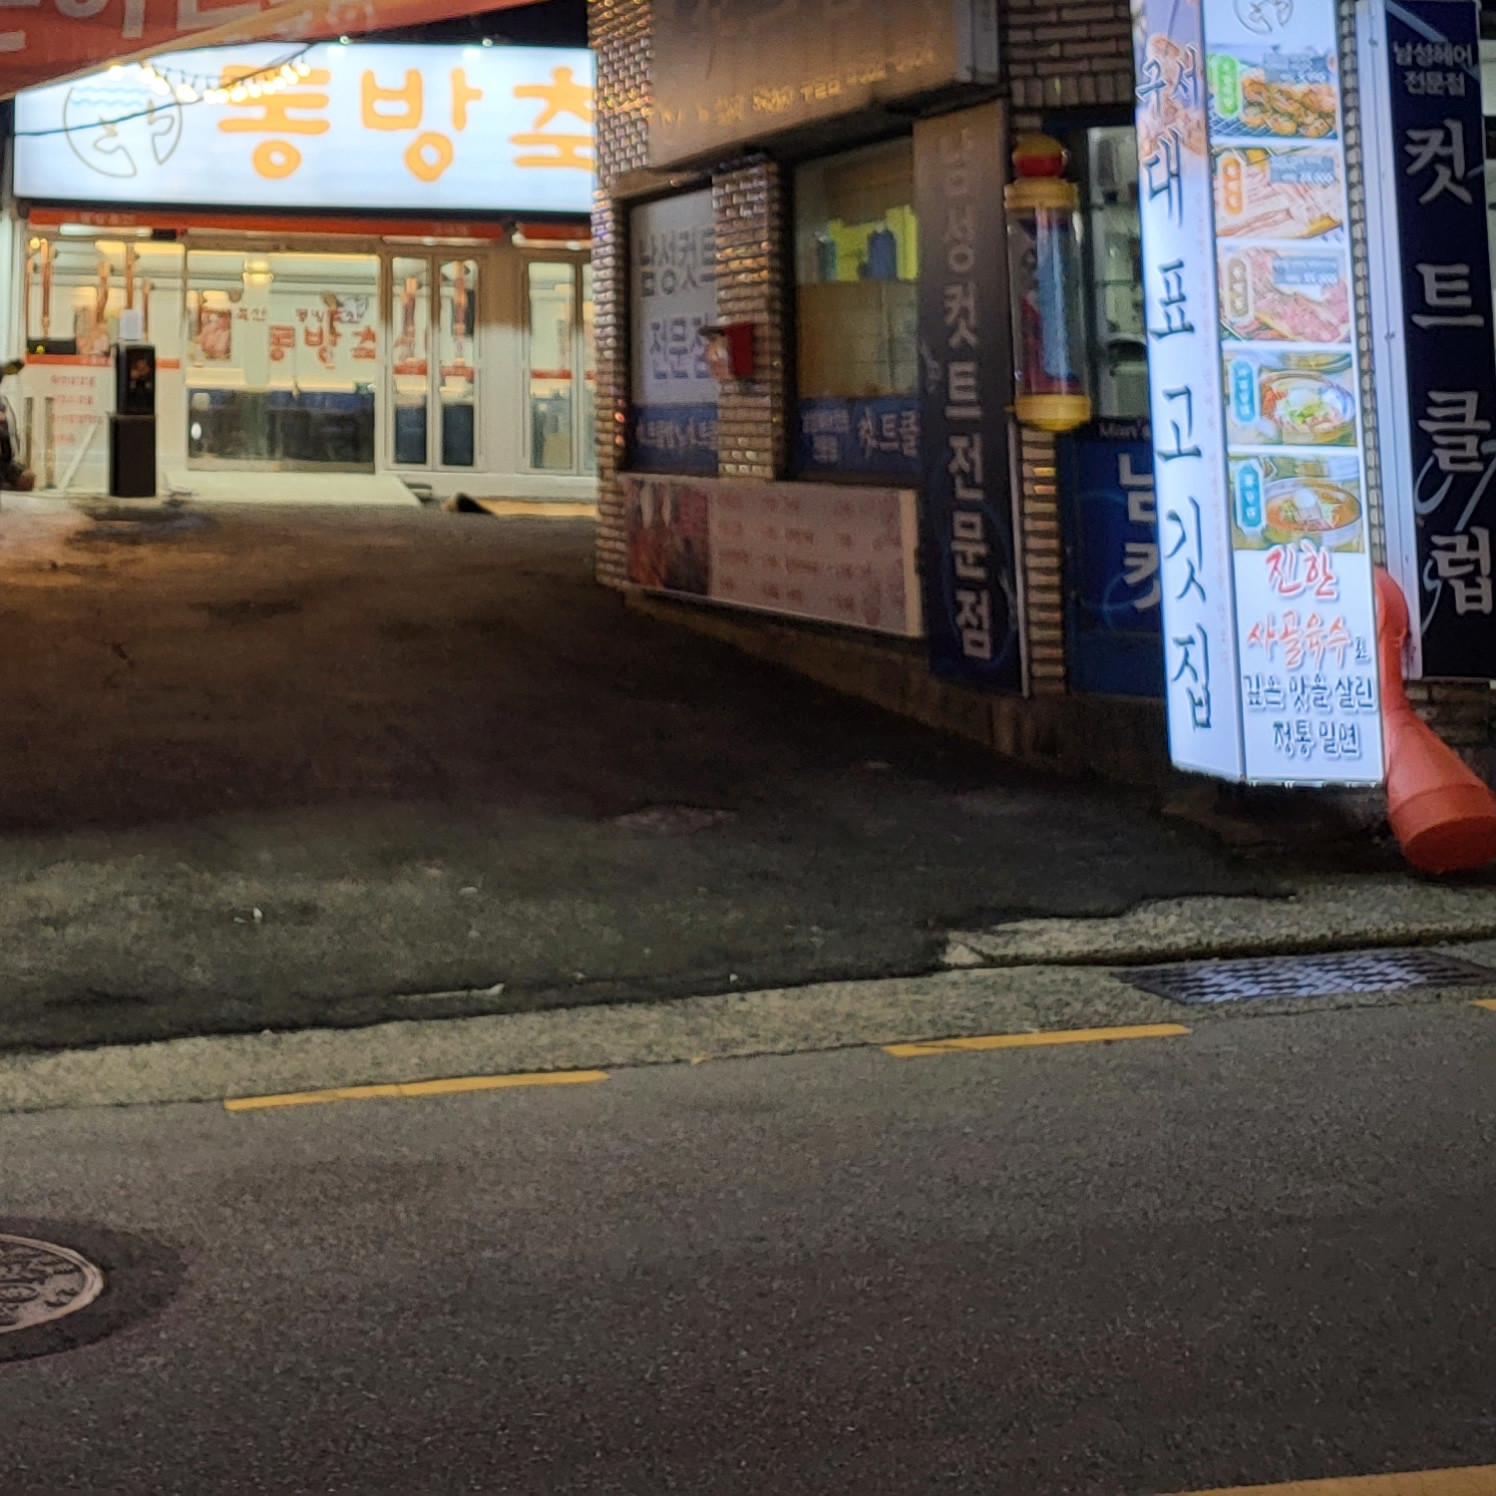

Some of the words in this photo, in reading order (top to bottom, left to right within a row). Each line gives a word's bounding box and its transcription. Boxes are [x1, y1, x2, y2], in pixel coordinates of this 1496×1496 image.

[1264, 541, 1338, 600] 진한
[1243, 675, 1285, 709] 깊은
[1288, 673, 1332, 711] 맛을
[1334, 675, 1377, 711] 살린
[1272, 719, 1316, 758] 정통
[1318, 720, 1361, 758] 밀면
